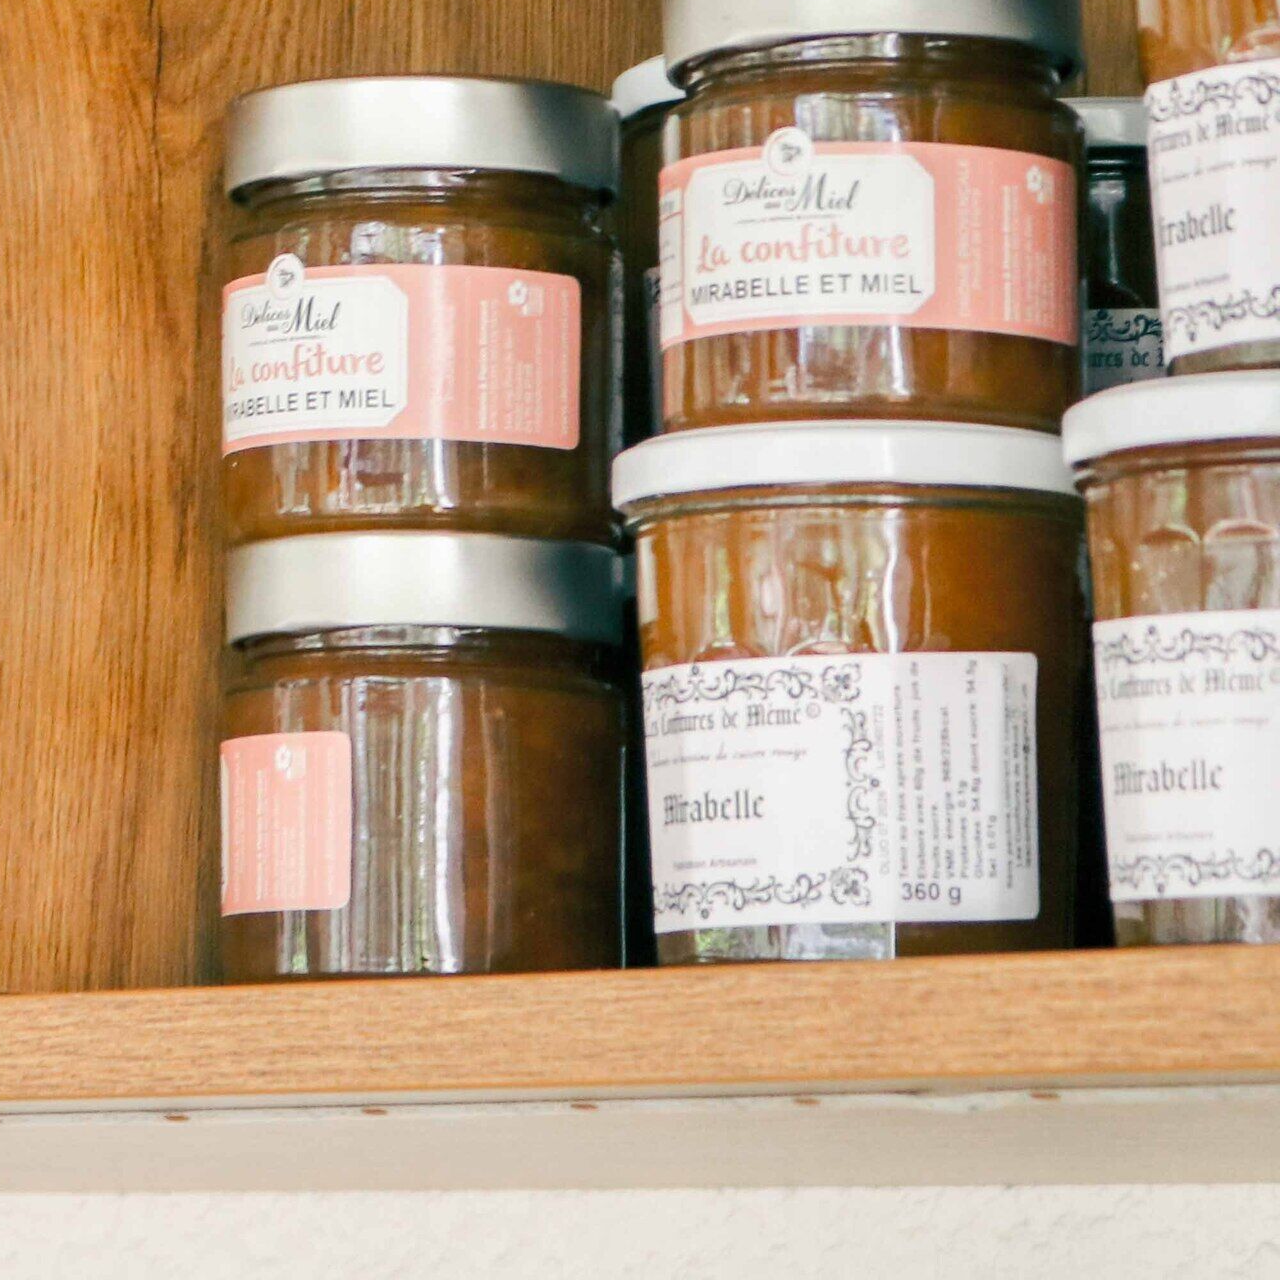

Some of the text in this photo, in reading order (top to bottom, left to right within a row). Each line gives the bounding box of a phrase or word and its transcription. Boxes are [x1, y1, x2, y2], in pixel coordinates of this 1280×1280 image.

[785, 172, 860, 213] Miel
[741, 219, 912, 266] confiture
[690, 272, 923, 306] MIRABELLE ET MIEL
[284, 296, 341, 333] Miel
[251, 344, 384, 384] confiture
[307, 390, 332, 409] ET
[338, 389, 395, 410] MIEL
[1113, 759, 1224, 796] Mirabelle
[664, 790, 765, 826] Mirabelle
[901, 882, 962, 905] 360 g
